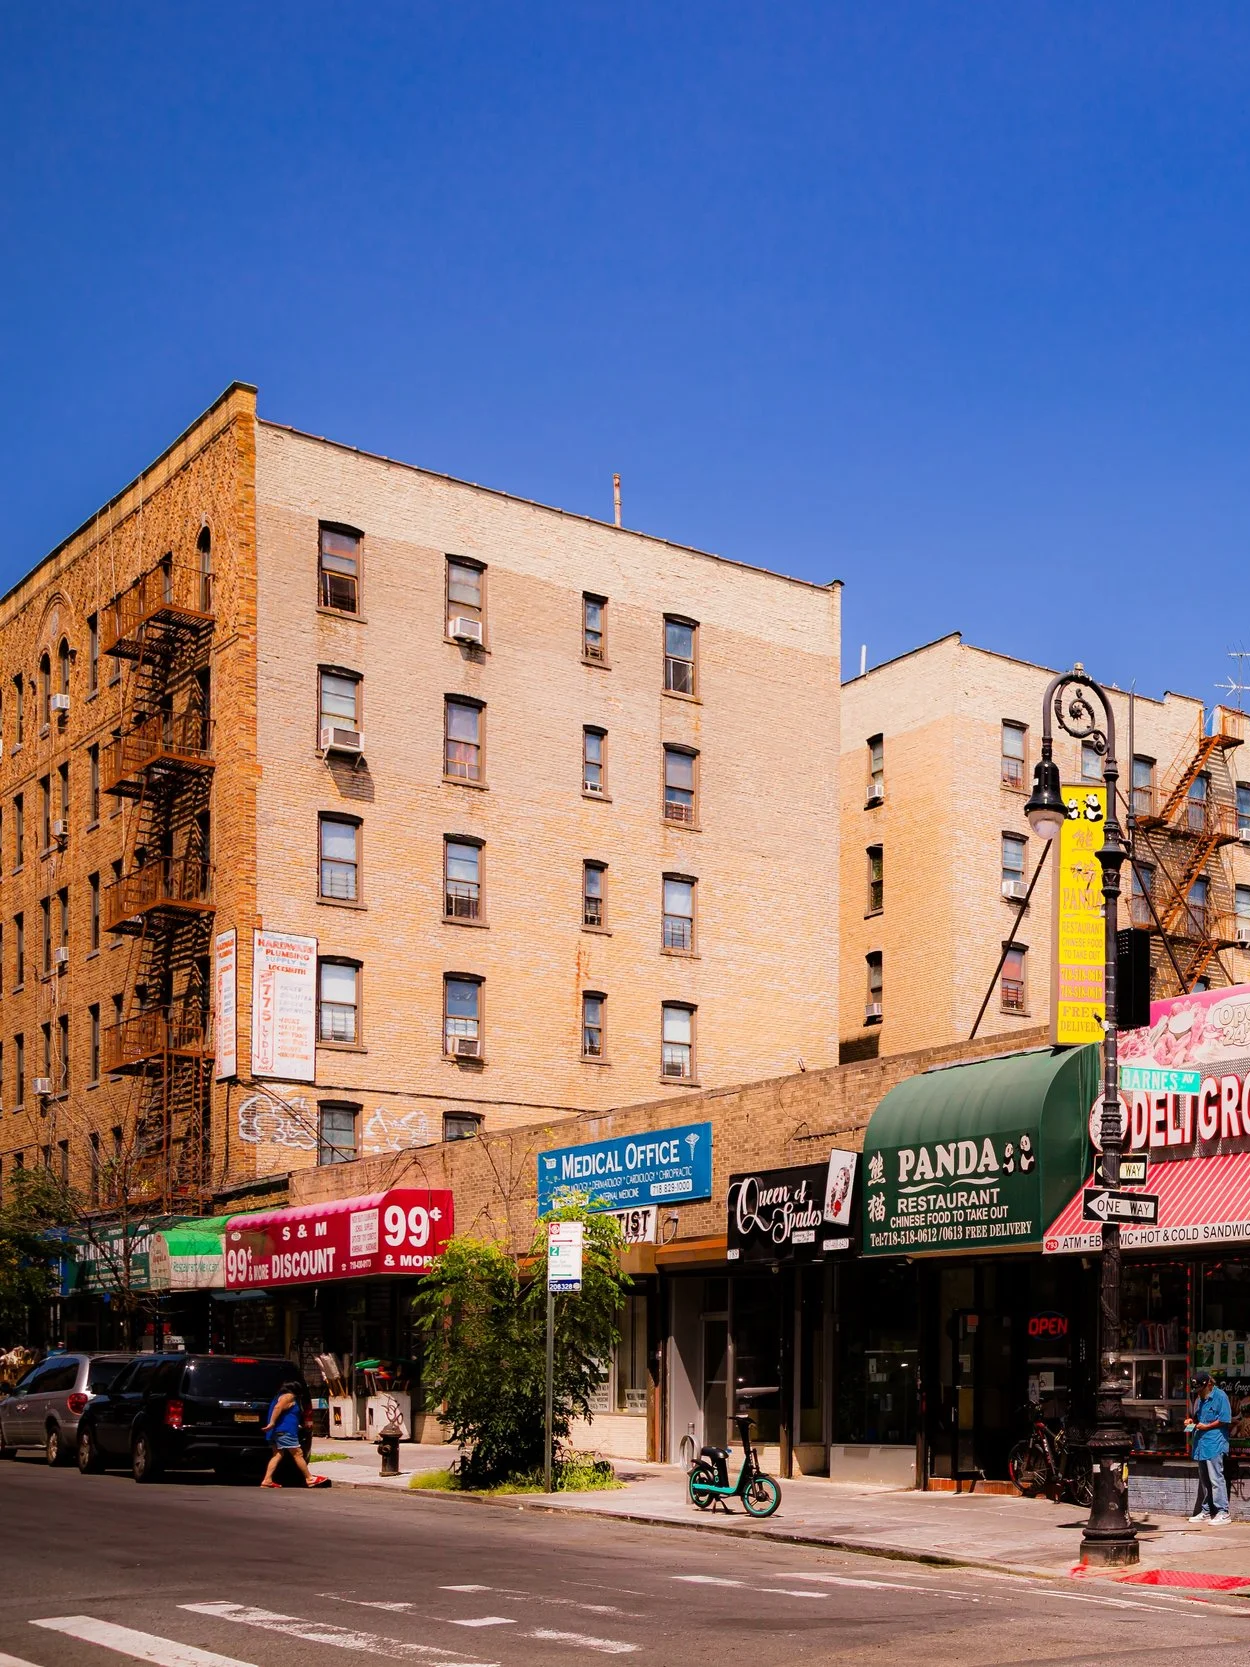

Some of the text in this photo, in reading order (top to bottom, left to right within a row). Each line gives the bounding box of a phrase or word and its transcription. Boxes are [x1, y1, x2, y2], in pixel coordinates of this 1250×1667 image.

[1062, 921, 1103, 934] RESTAURANT
[1122, 1069, 1179, 1092] BARNES
[1130, 1090, 1197, 1149] DELI
[562, 1140, 680, 1180] MEDICAL OFFICE
[898, 1138, 1000, 1182] PANDA
[1125, 1163, 1141, 1177] WAY
[898, 1188, 1001, 1214] RESTAURANT
[1097, 1199, 1150, 1216] ONE WAY
[772, 1200, 822, 1244] Spades
[890, 1205, 1009, 1228] CHINESE FOOD TO TAKE OUT
[282, 1222, 327, 1241] S & M
[965, 1222, 988, 1239] FREE
[990, 1221, 1032, 1237] DELIVERY
[1063, 1237, 1082, 1249] ATM
[1089, 1235, 1102, 1247] EB
[1140, 1230, 1160, 1244] HOT
[1171, 1228, 1199, 1242] COLD
[272, 1247, 336, 1279] DISCOUNT
[1028, 1317, 1069, 1336] OPEN
